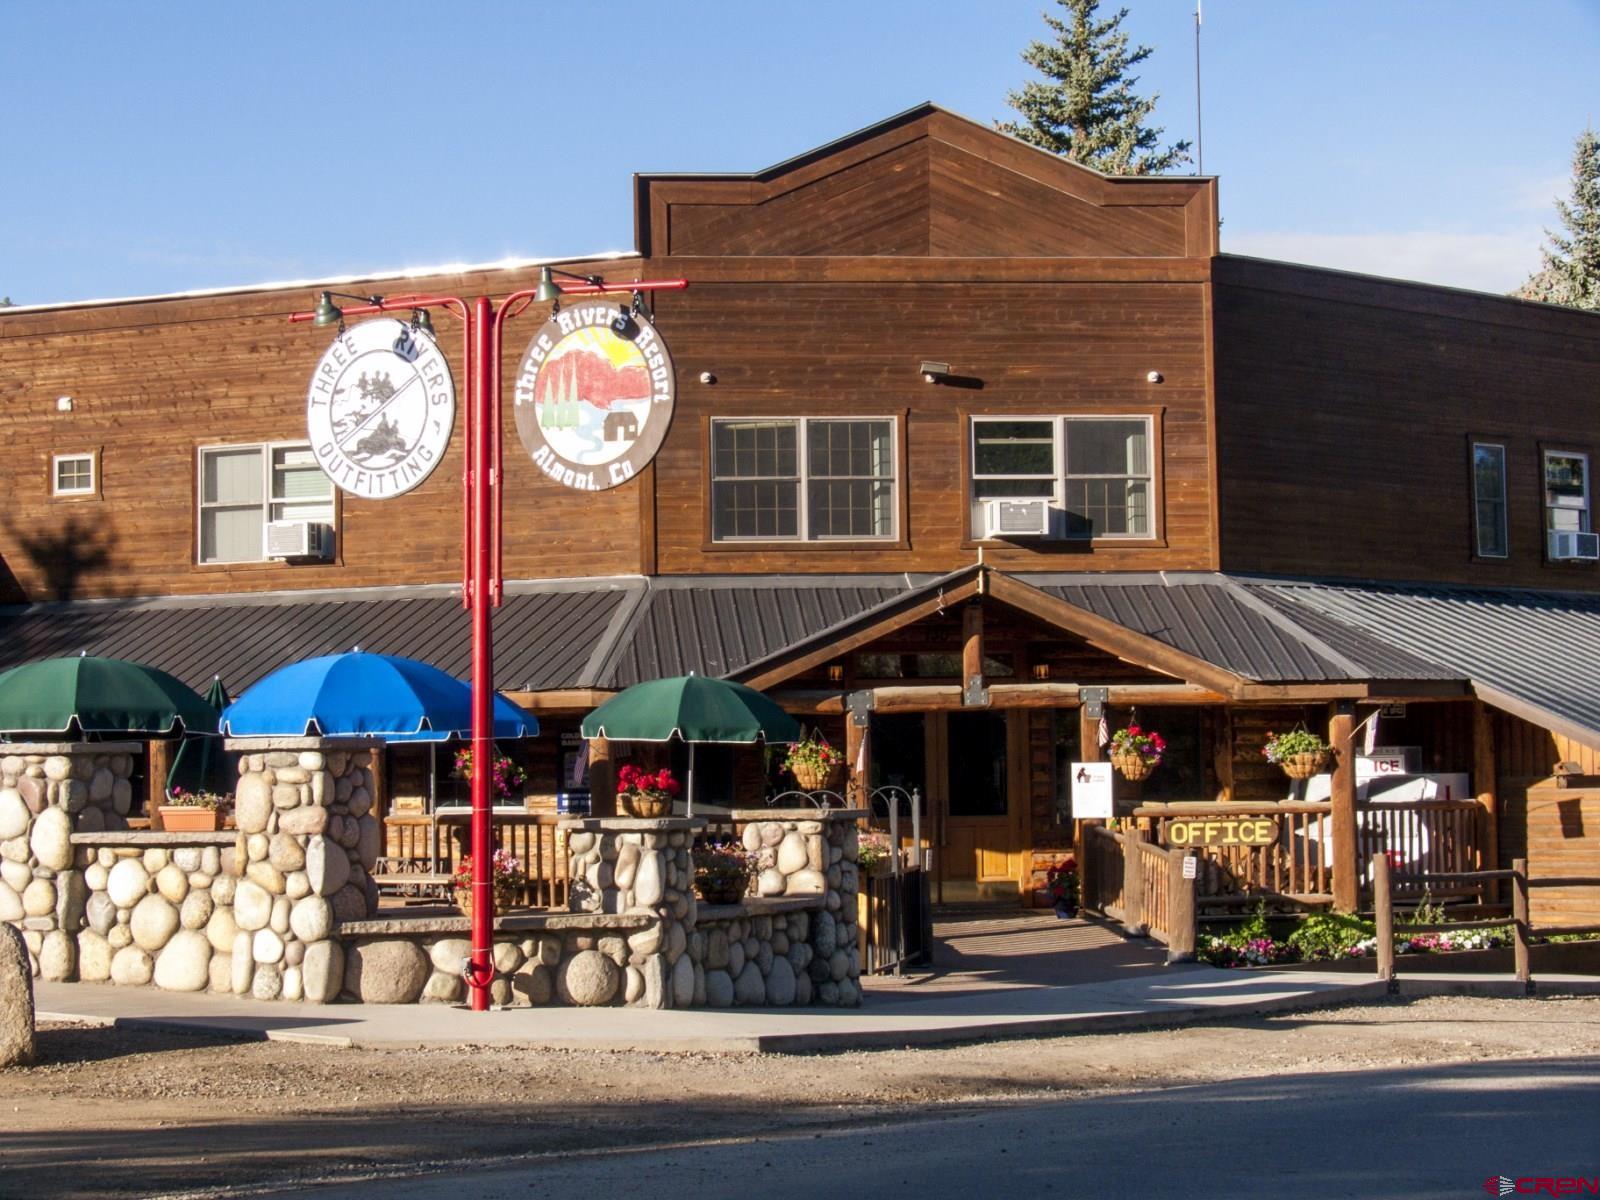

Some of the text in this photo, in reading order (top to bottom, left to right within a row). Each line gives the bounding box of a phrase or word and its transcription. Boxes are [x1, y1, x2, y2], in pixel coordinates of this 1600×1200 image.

[311, 329, 448, 408] THREE RIVERS
[319, 442, 433, 494] OUTFITTING
[1373, 760, 1400, 772] ICE
[1170, 821, 1272, 844] OFFICE
